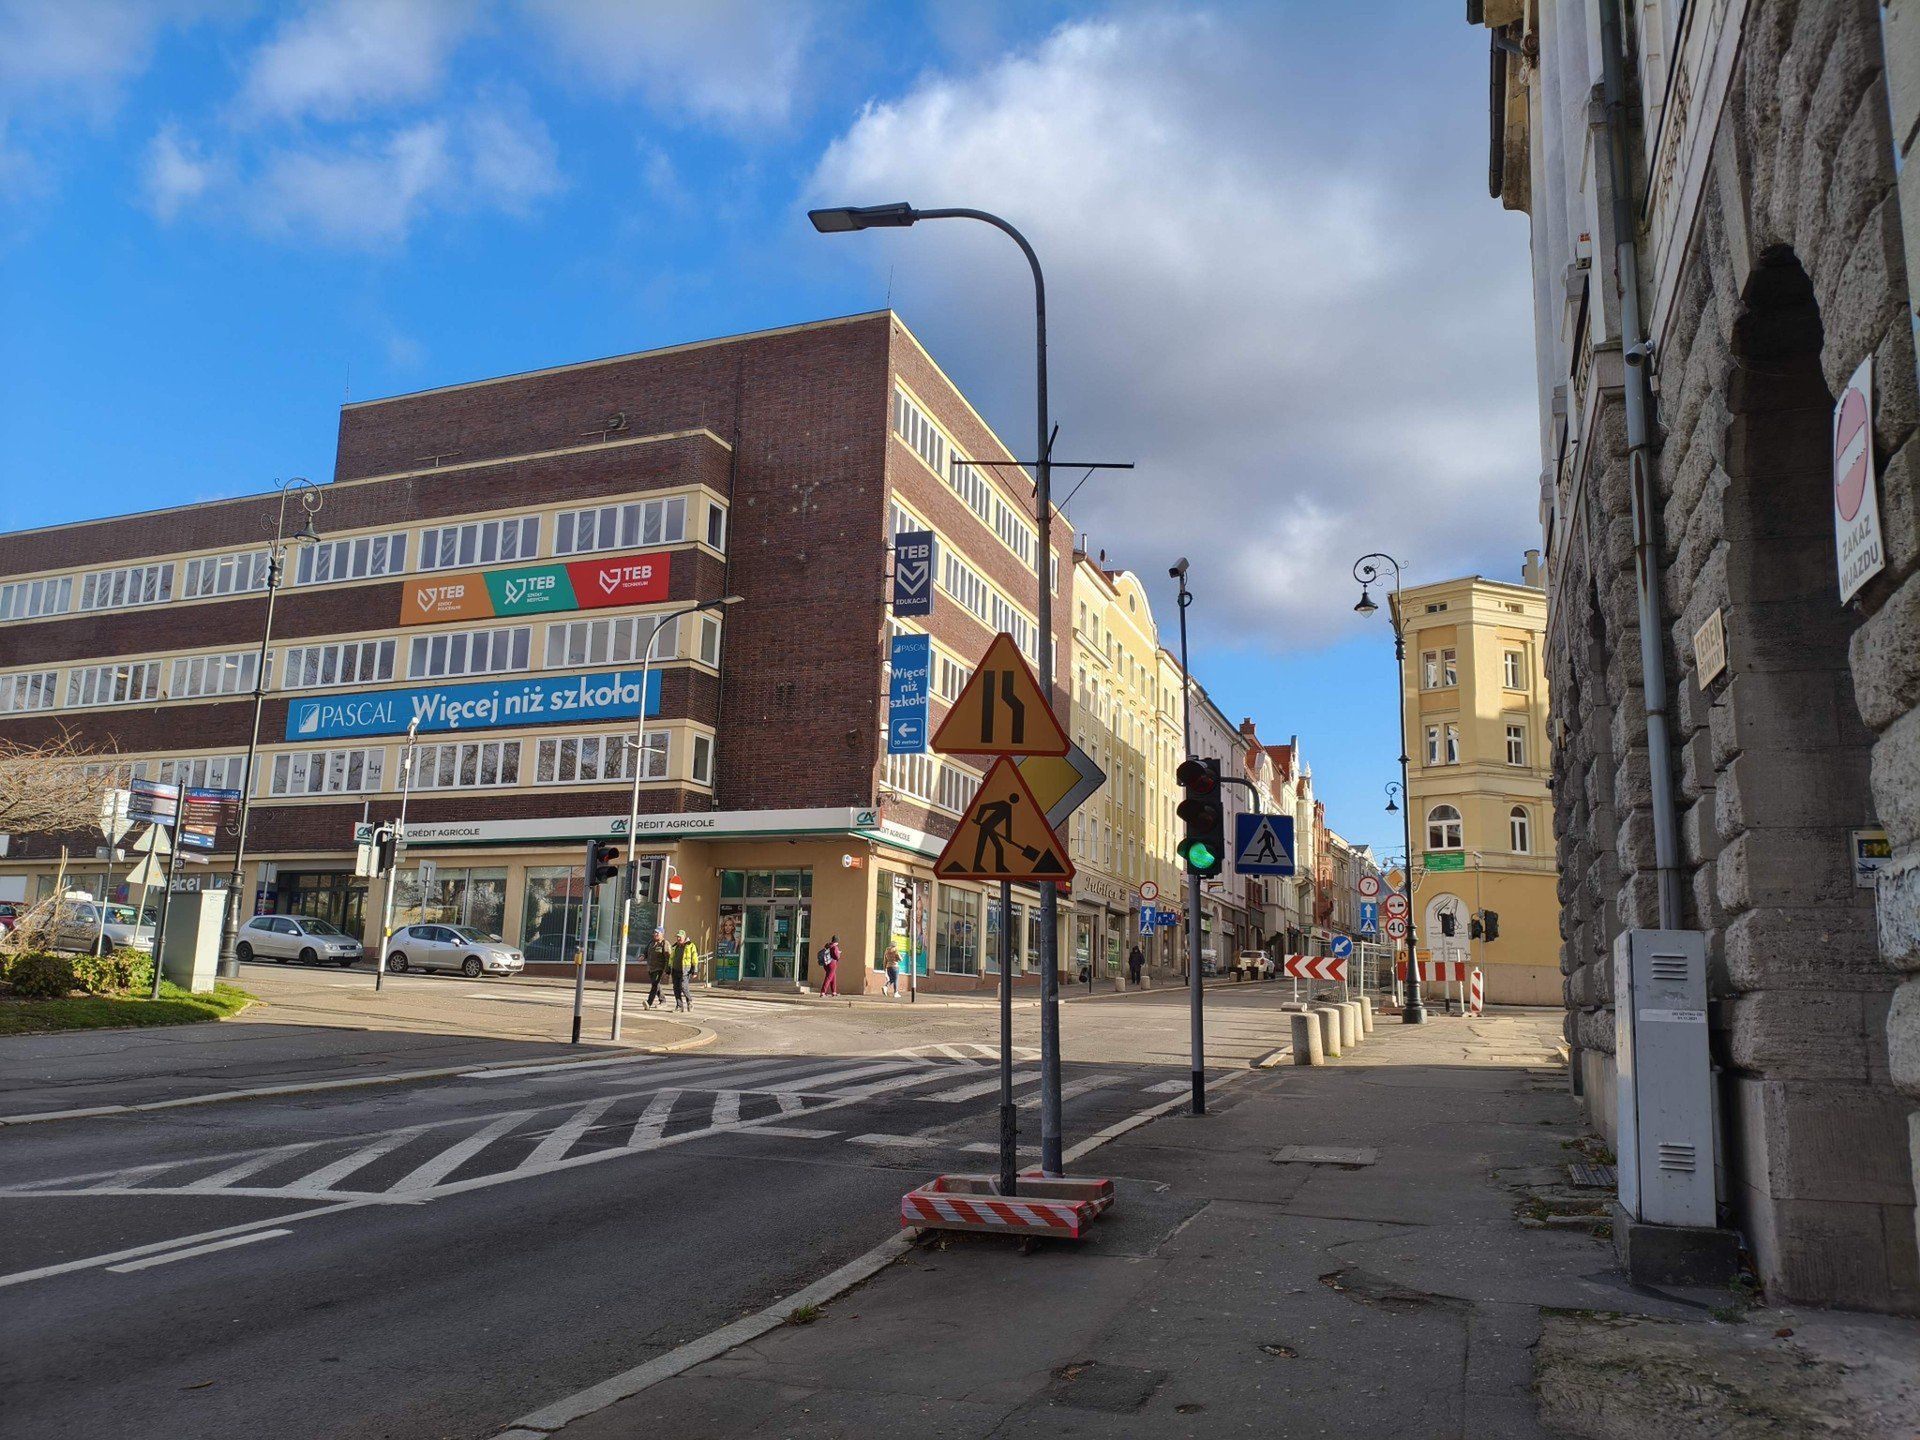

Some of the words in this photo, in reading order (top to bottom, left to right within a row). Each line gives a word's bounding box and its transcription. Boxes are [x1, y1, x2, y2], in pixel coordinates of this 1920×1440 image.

[1842, 514, 1871, 562] ZAKAZ
[898, 544, 929, 559] TEB
[622, 565, 652, 580] TEB
[1842, 541, 1879, 594] WJAZDU
[528, 575, 556, 590] TEB
[439, 585, 465, 599] TEB
[1695, 614, 1721, 659] TEREN
[901, 643, 928, 653] PASCAL
[891, 665, 928, 681] Więcej
[900, 681, 918, 693] niż
[411, 690, 499, 728] Więcej
[504, 685, 544, 715] niż
[550, 673, 640, 711] szkoła
[321, 701, 396, 728] PASCAL
[637, 820, 665, 829] RÉDIT
[666, 819, 715, 828] AGRICOLE
[407, 829, 436, 838] CRÉDIT
[438, 828, 480, 837] AGRICOLE
[1389, 922, 1405, 933] 40
